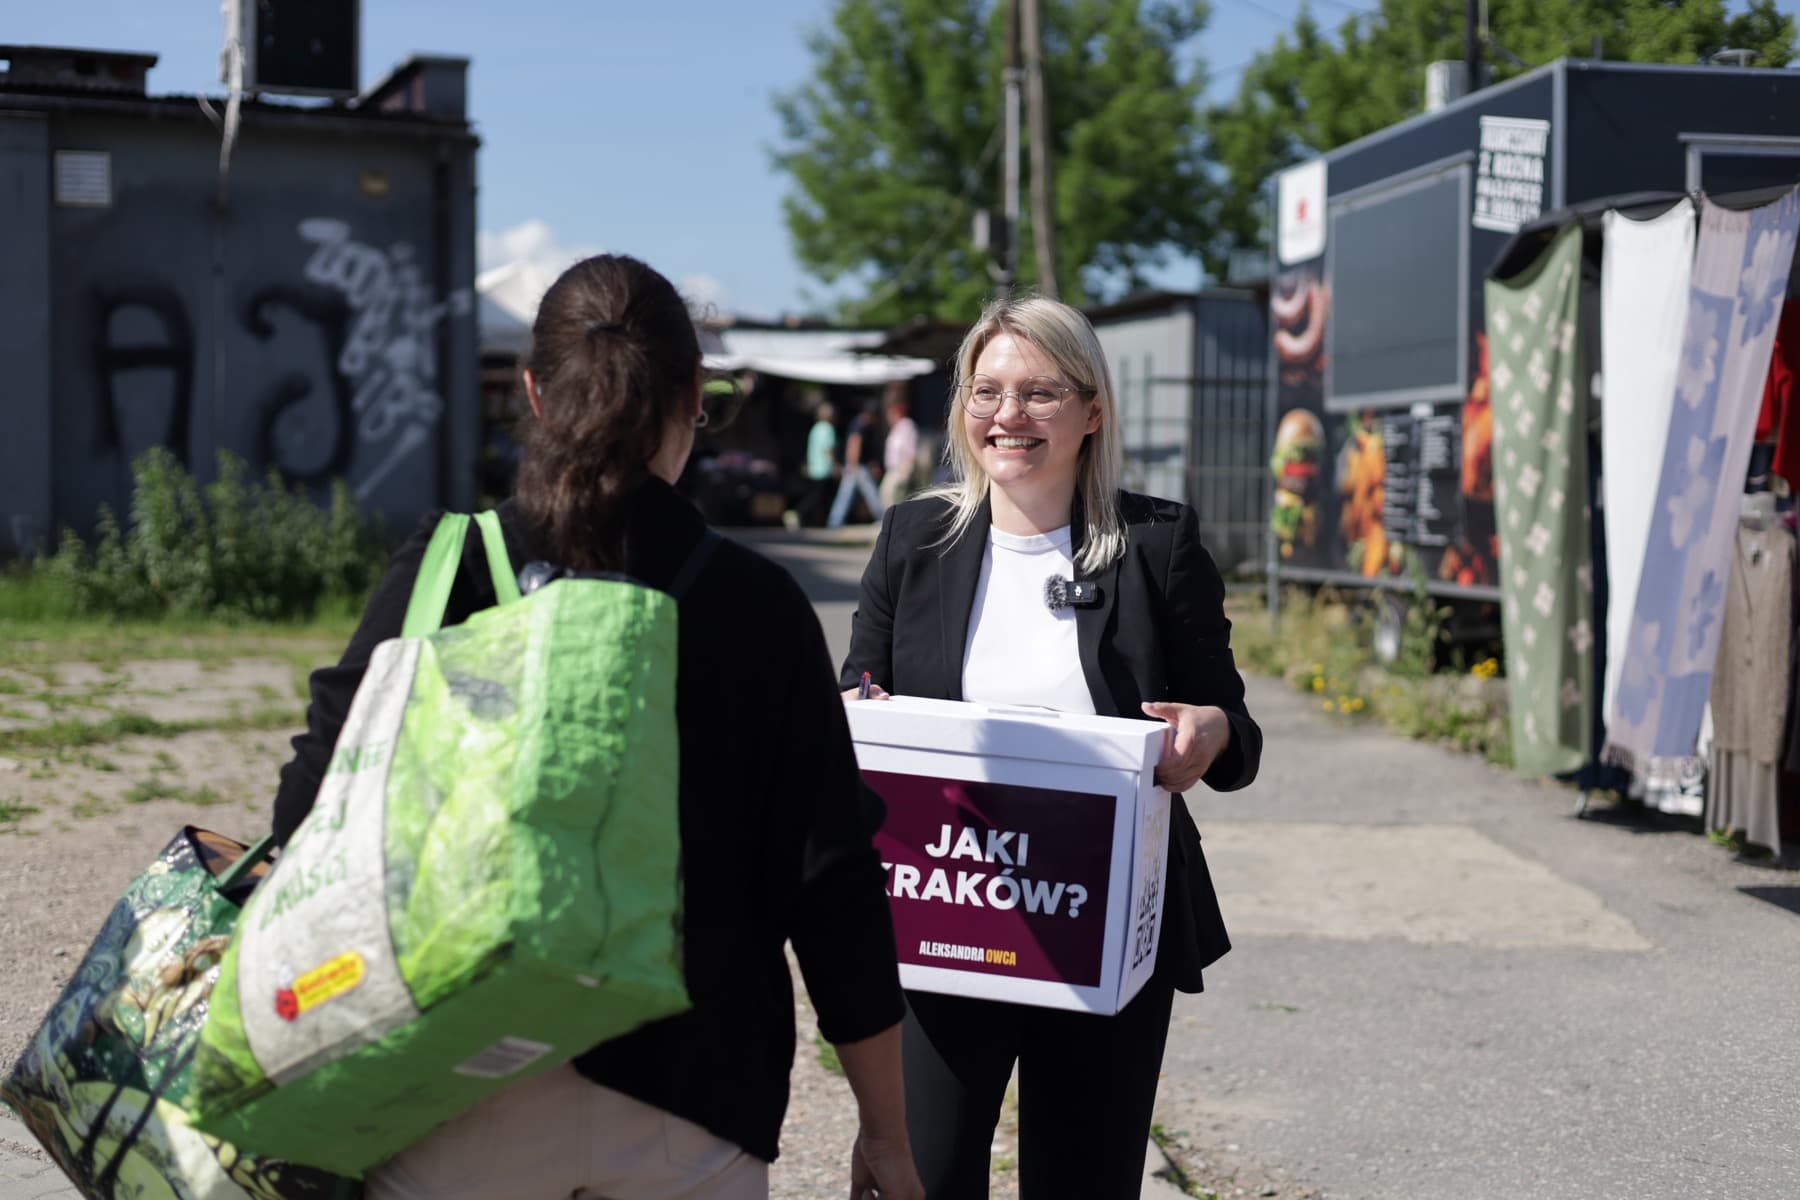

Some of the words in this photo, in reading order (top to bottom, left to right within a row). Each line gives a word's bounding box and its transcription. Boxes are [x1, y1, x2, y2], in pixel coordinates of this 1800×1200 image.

[924, 824, 1029, 866] JAKI
[919, 940, 984, 962] ALEKSANDRA
[985, 949, 1016, 966] OWCA
